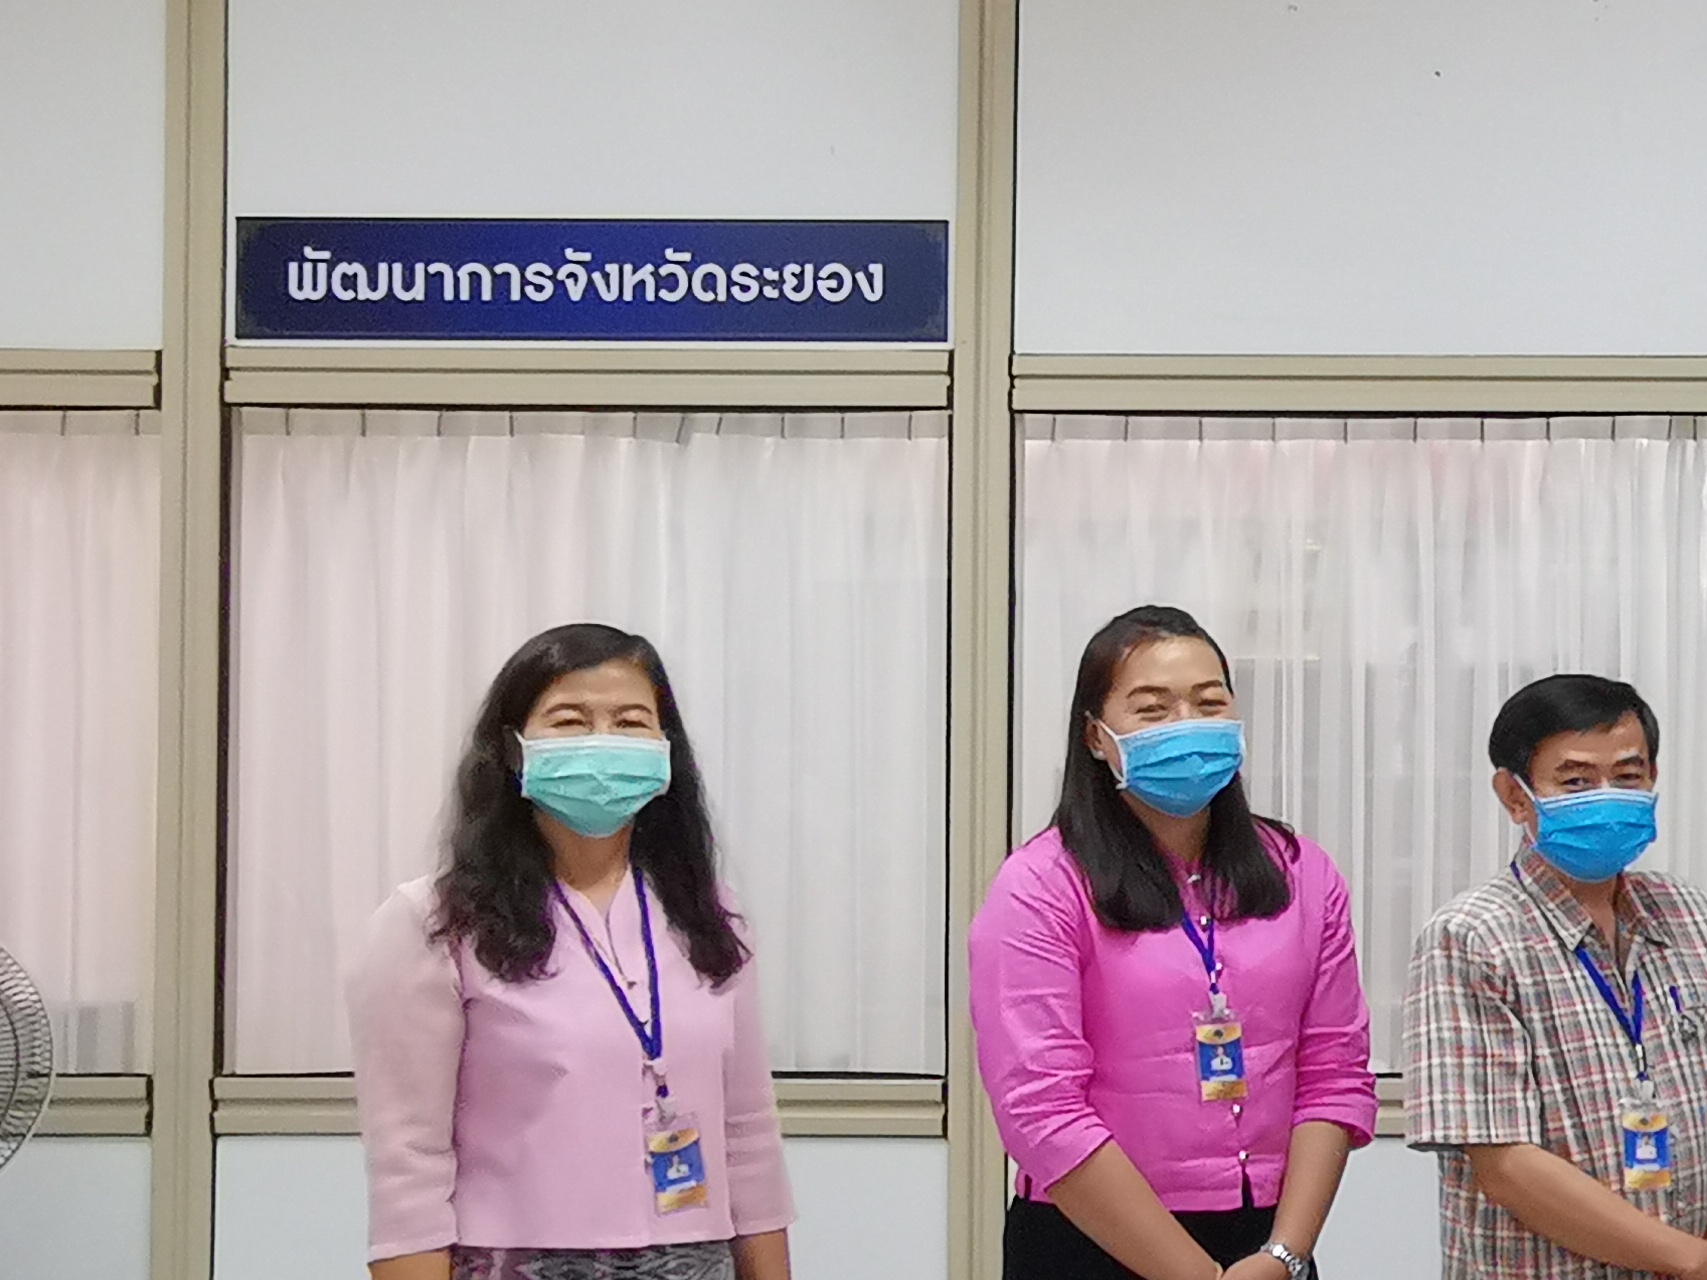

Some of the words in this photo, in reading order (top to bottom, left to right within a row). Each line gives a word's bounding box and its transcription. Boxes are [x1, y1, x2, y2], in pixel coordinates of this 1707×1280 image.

[287, 246, 885, 303] พัฒนาการจังหวัดระยอง
